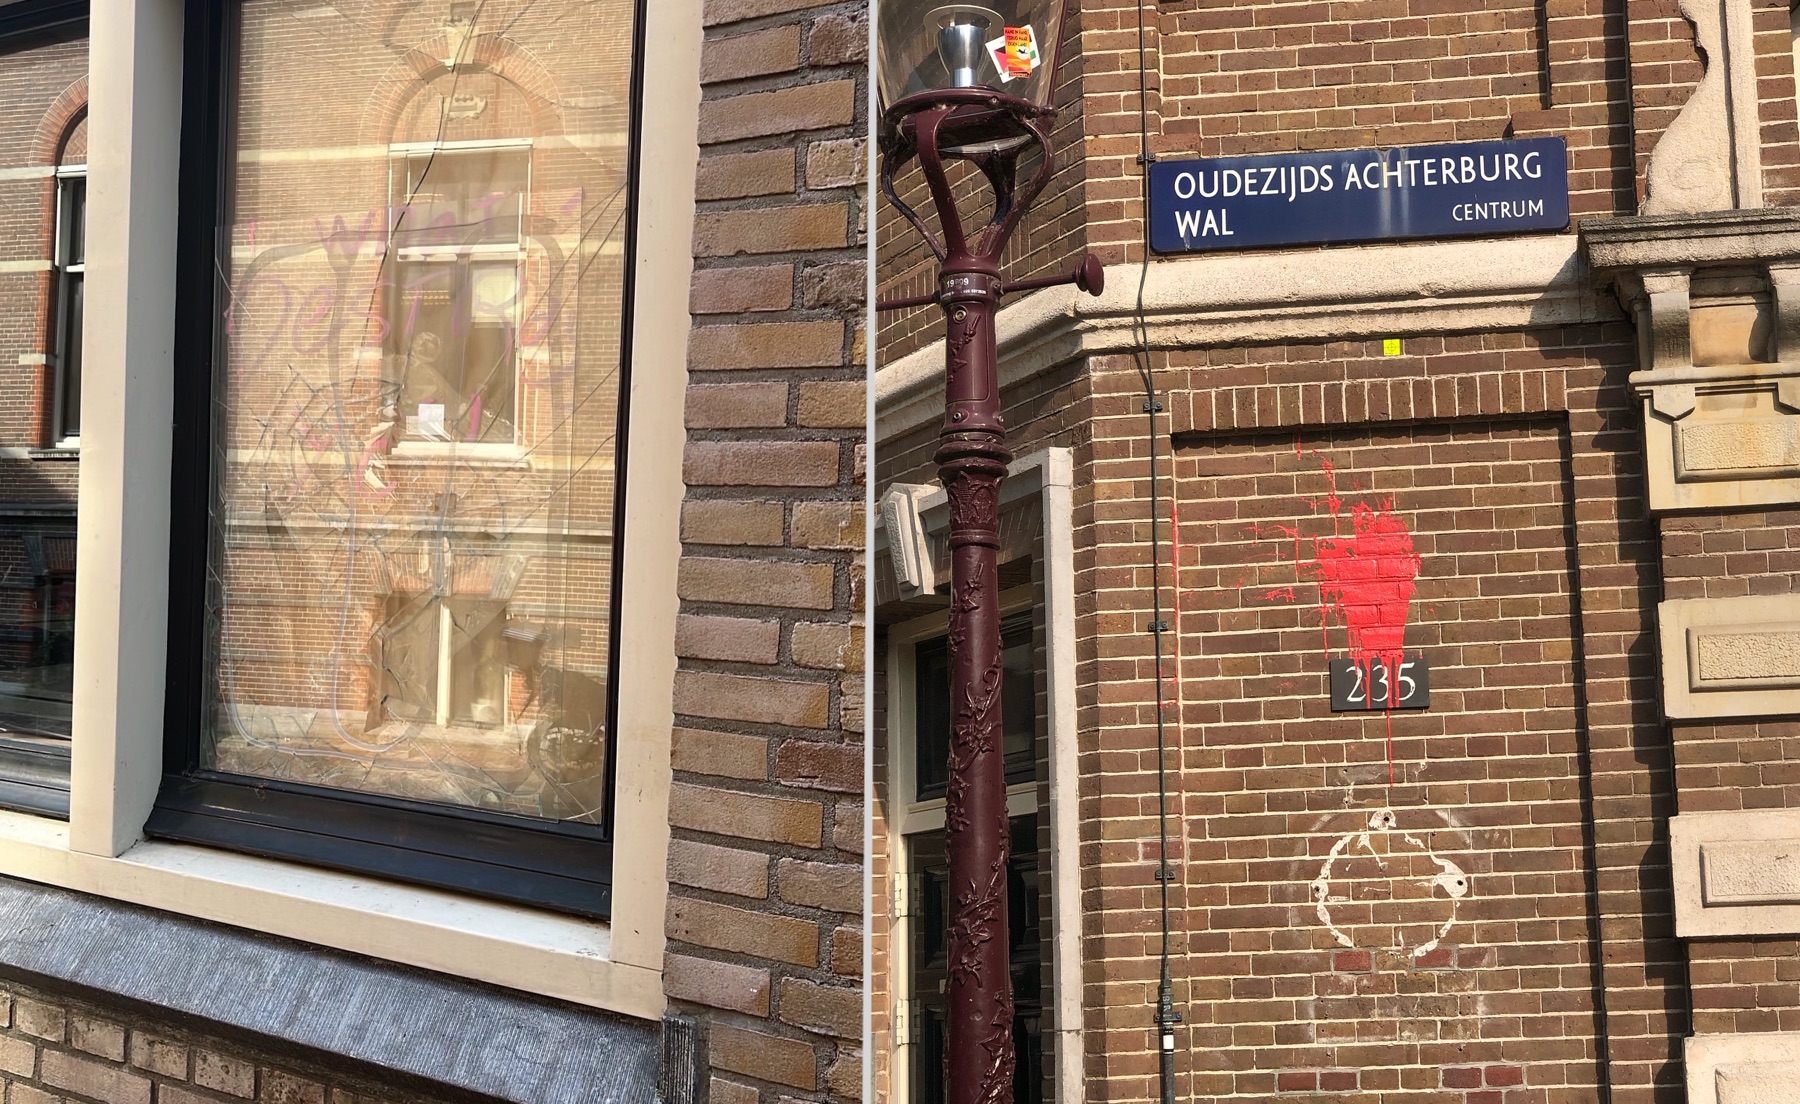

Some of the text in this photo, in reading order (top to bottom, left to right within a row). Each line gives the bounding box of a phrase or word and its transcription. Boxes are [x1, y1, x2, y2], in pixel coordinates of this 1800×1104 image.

[1174, 152, 1542, 202] OUDEZIJDS ACHTERBURG
[1175, 209, 1234, 238] WAL
[1452, 199, 1543, 222] CENTRUM
[1345, 662, 1416, 702] 235
